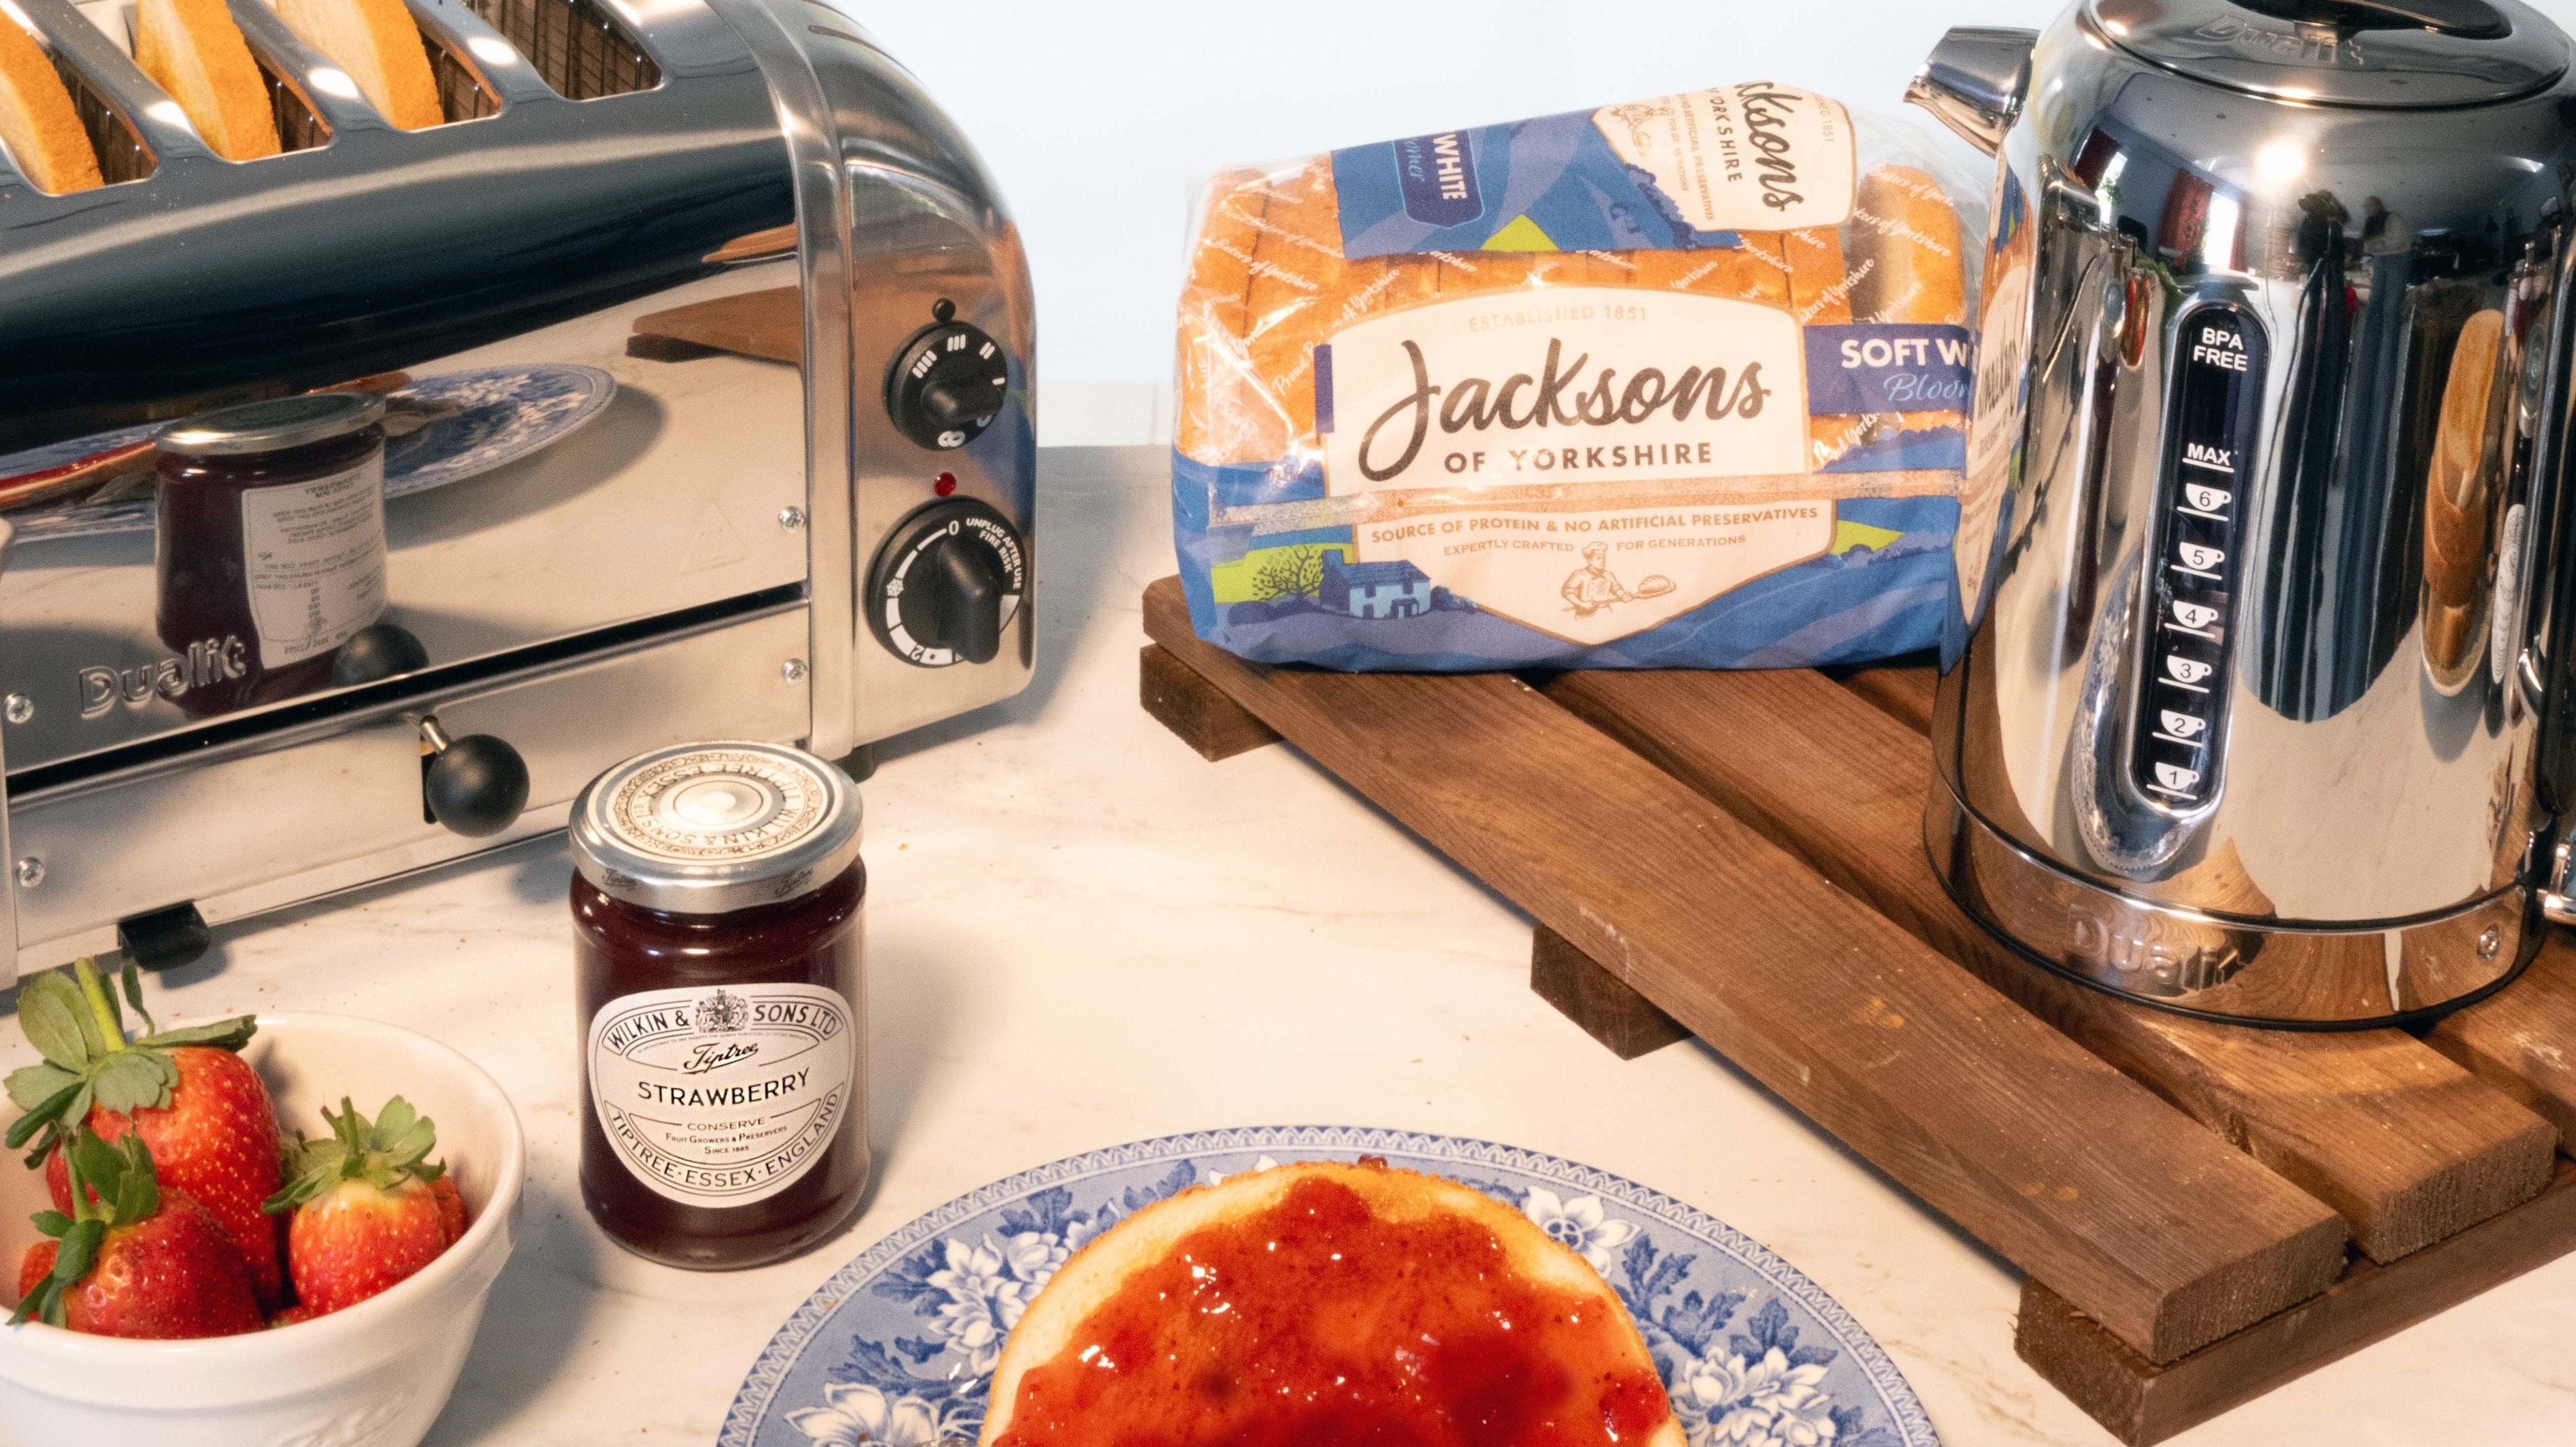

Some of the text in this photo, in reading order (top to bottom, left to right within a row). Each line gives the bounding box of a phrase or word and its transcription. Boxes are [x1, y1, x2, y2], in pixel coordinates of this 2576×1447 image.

[1733, 81, 1804, 212] cksons
[1432, 133, 1468, 200] WHITE
[1469, 304, 1647, 332] ESTABLISHED 1851
[1841, 338, 1967, 369] SOFT W
[2202, 327, 2244, 351] BPA
[2193, 344, 2248, 372] FREE
[1359, 337, 1772, 481] Jacksons
[1444, 442, 1712, 474] OF YORKSHIRE
[2187, 442, 2231, 467] MAX
[2199, 491, 2211, 507] 6
[1372, 507, 1818, 544] SOURCE OF PROTEIN & NO ARTIFICIAL PRESERVATIVES
[966, 517, 1022, 590] UNPLUG AFTER USE
[979, 530, 1014, 574] FIRE RISK
[1443, 535, 1746, 556] EXPERTLY CRAFTED FOR GENERATIONS
[2192, 550, 2205, 566] 5
[2185, 609, 2198, 624] 4
[79, 635, 246, 720] Dualit
[2180, 663, 2192, 679] 3
[2174, 718, 2186, 733] 2
[640, 765, 703, 799] ESSEX
[2169, 770, 2179, 785] 1
[643, 819, 697, 845] SONS
[723, 809, 796, 845] WILKIN
[2067, 903, 2246, 992] Dualit
[608, 1012, 668, 1050] WILKIN
[675, 1010, 689, 1028] &
[753, 1004, 809, 1023] SONS
[810, 1009, 837, 1035] LTD
[682, 1040, 759, 1075] Tiptree
[638, 1067, 810, 1107] STRAWBERRY
[687, 1117, 766, 1130] CONSERVE
